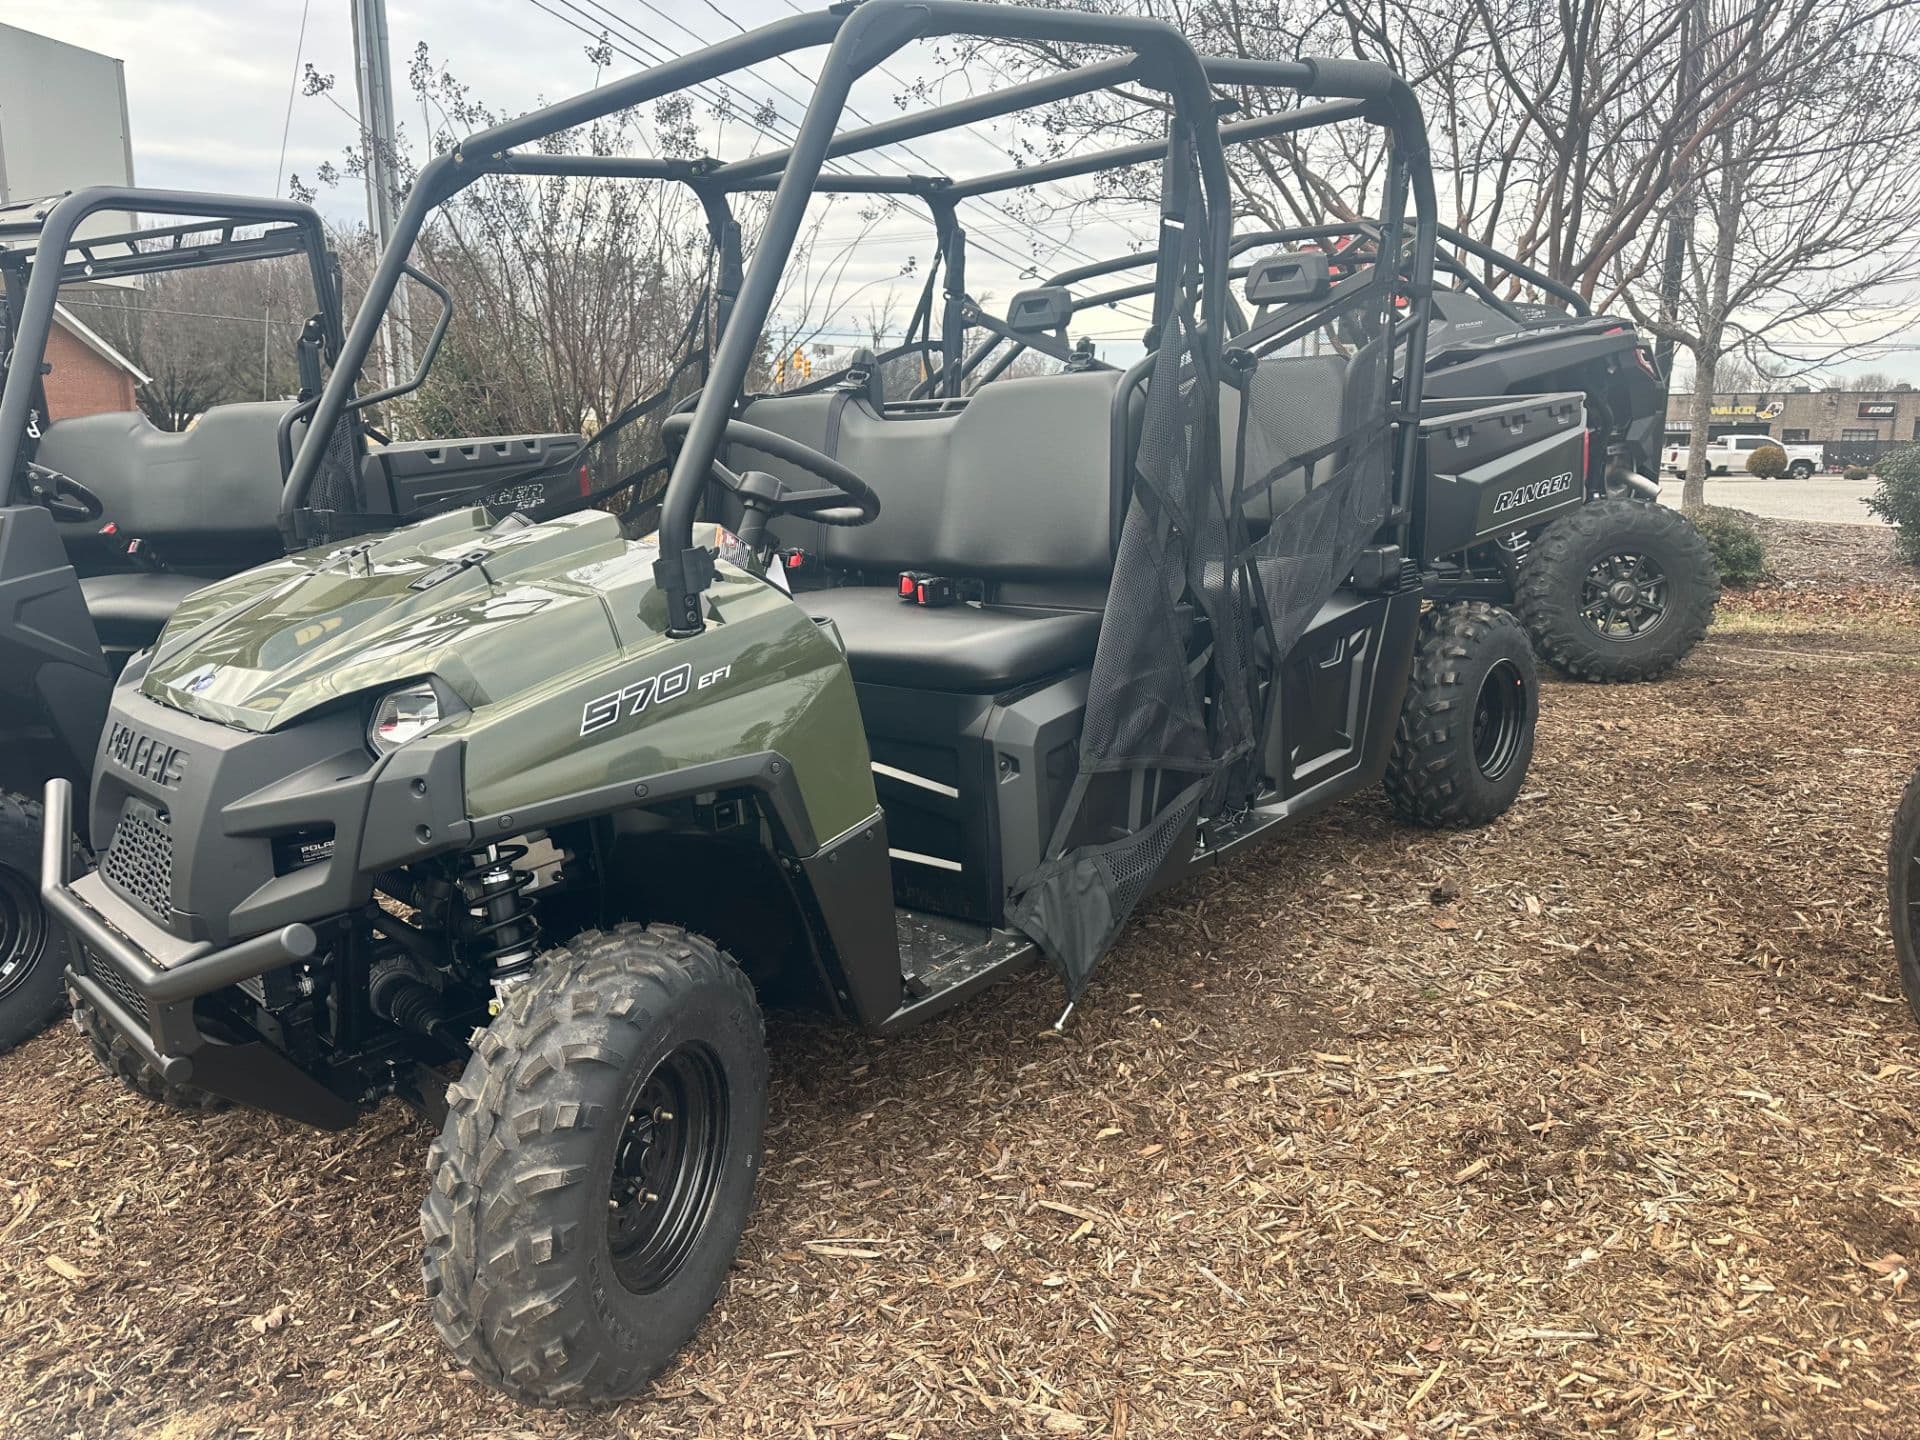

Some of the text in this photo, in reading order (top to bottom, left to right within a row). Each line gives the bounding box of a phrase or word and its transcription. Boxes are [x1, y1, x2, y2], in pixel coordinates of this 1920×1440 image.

[1711, 406, 1756, 415] WALKER
[1867, 406, 1894, 414] ECHO
[1493, 472, 1572, 514] RANGER
[580, 663, 731, 736] 570 EFI
[105, 721, 192, 792] POLARIS
